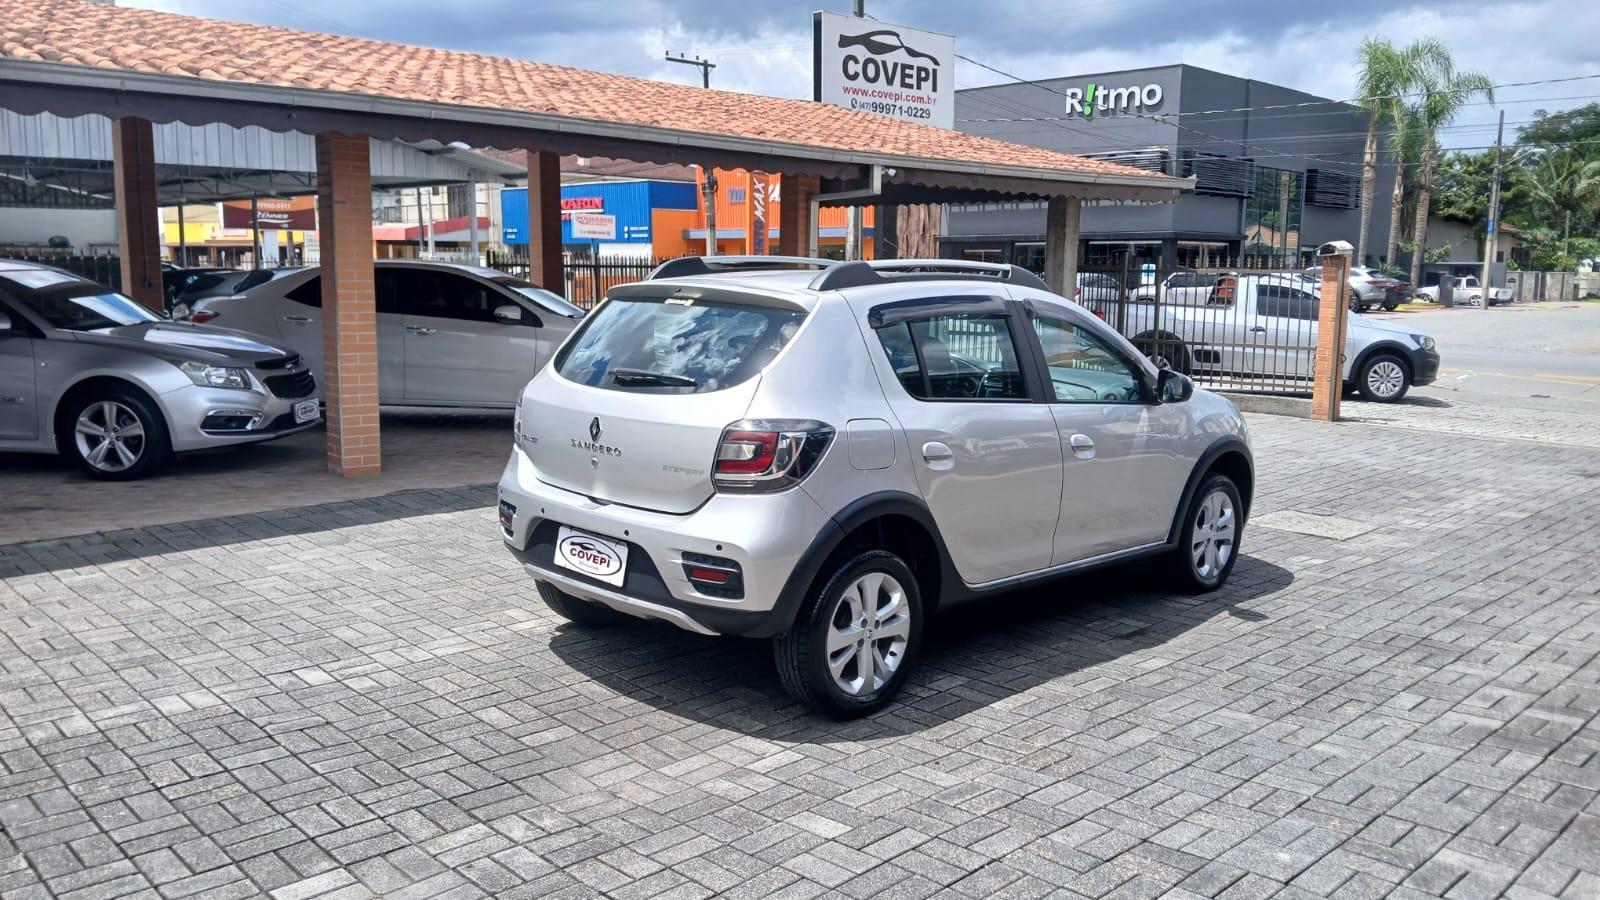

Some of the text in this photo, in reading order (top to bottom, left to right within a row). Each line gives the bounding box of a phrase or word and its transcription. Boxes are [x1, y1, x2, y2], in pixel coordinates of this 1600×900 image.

[842, 54, 938, 93] COVEPI
[842, 86, 937, 105] www.covepi.com.br
[570, 438, 622, 457] SANDERO
[570, 547, 611, 568] COVEPI
